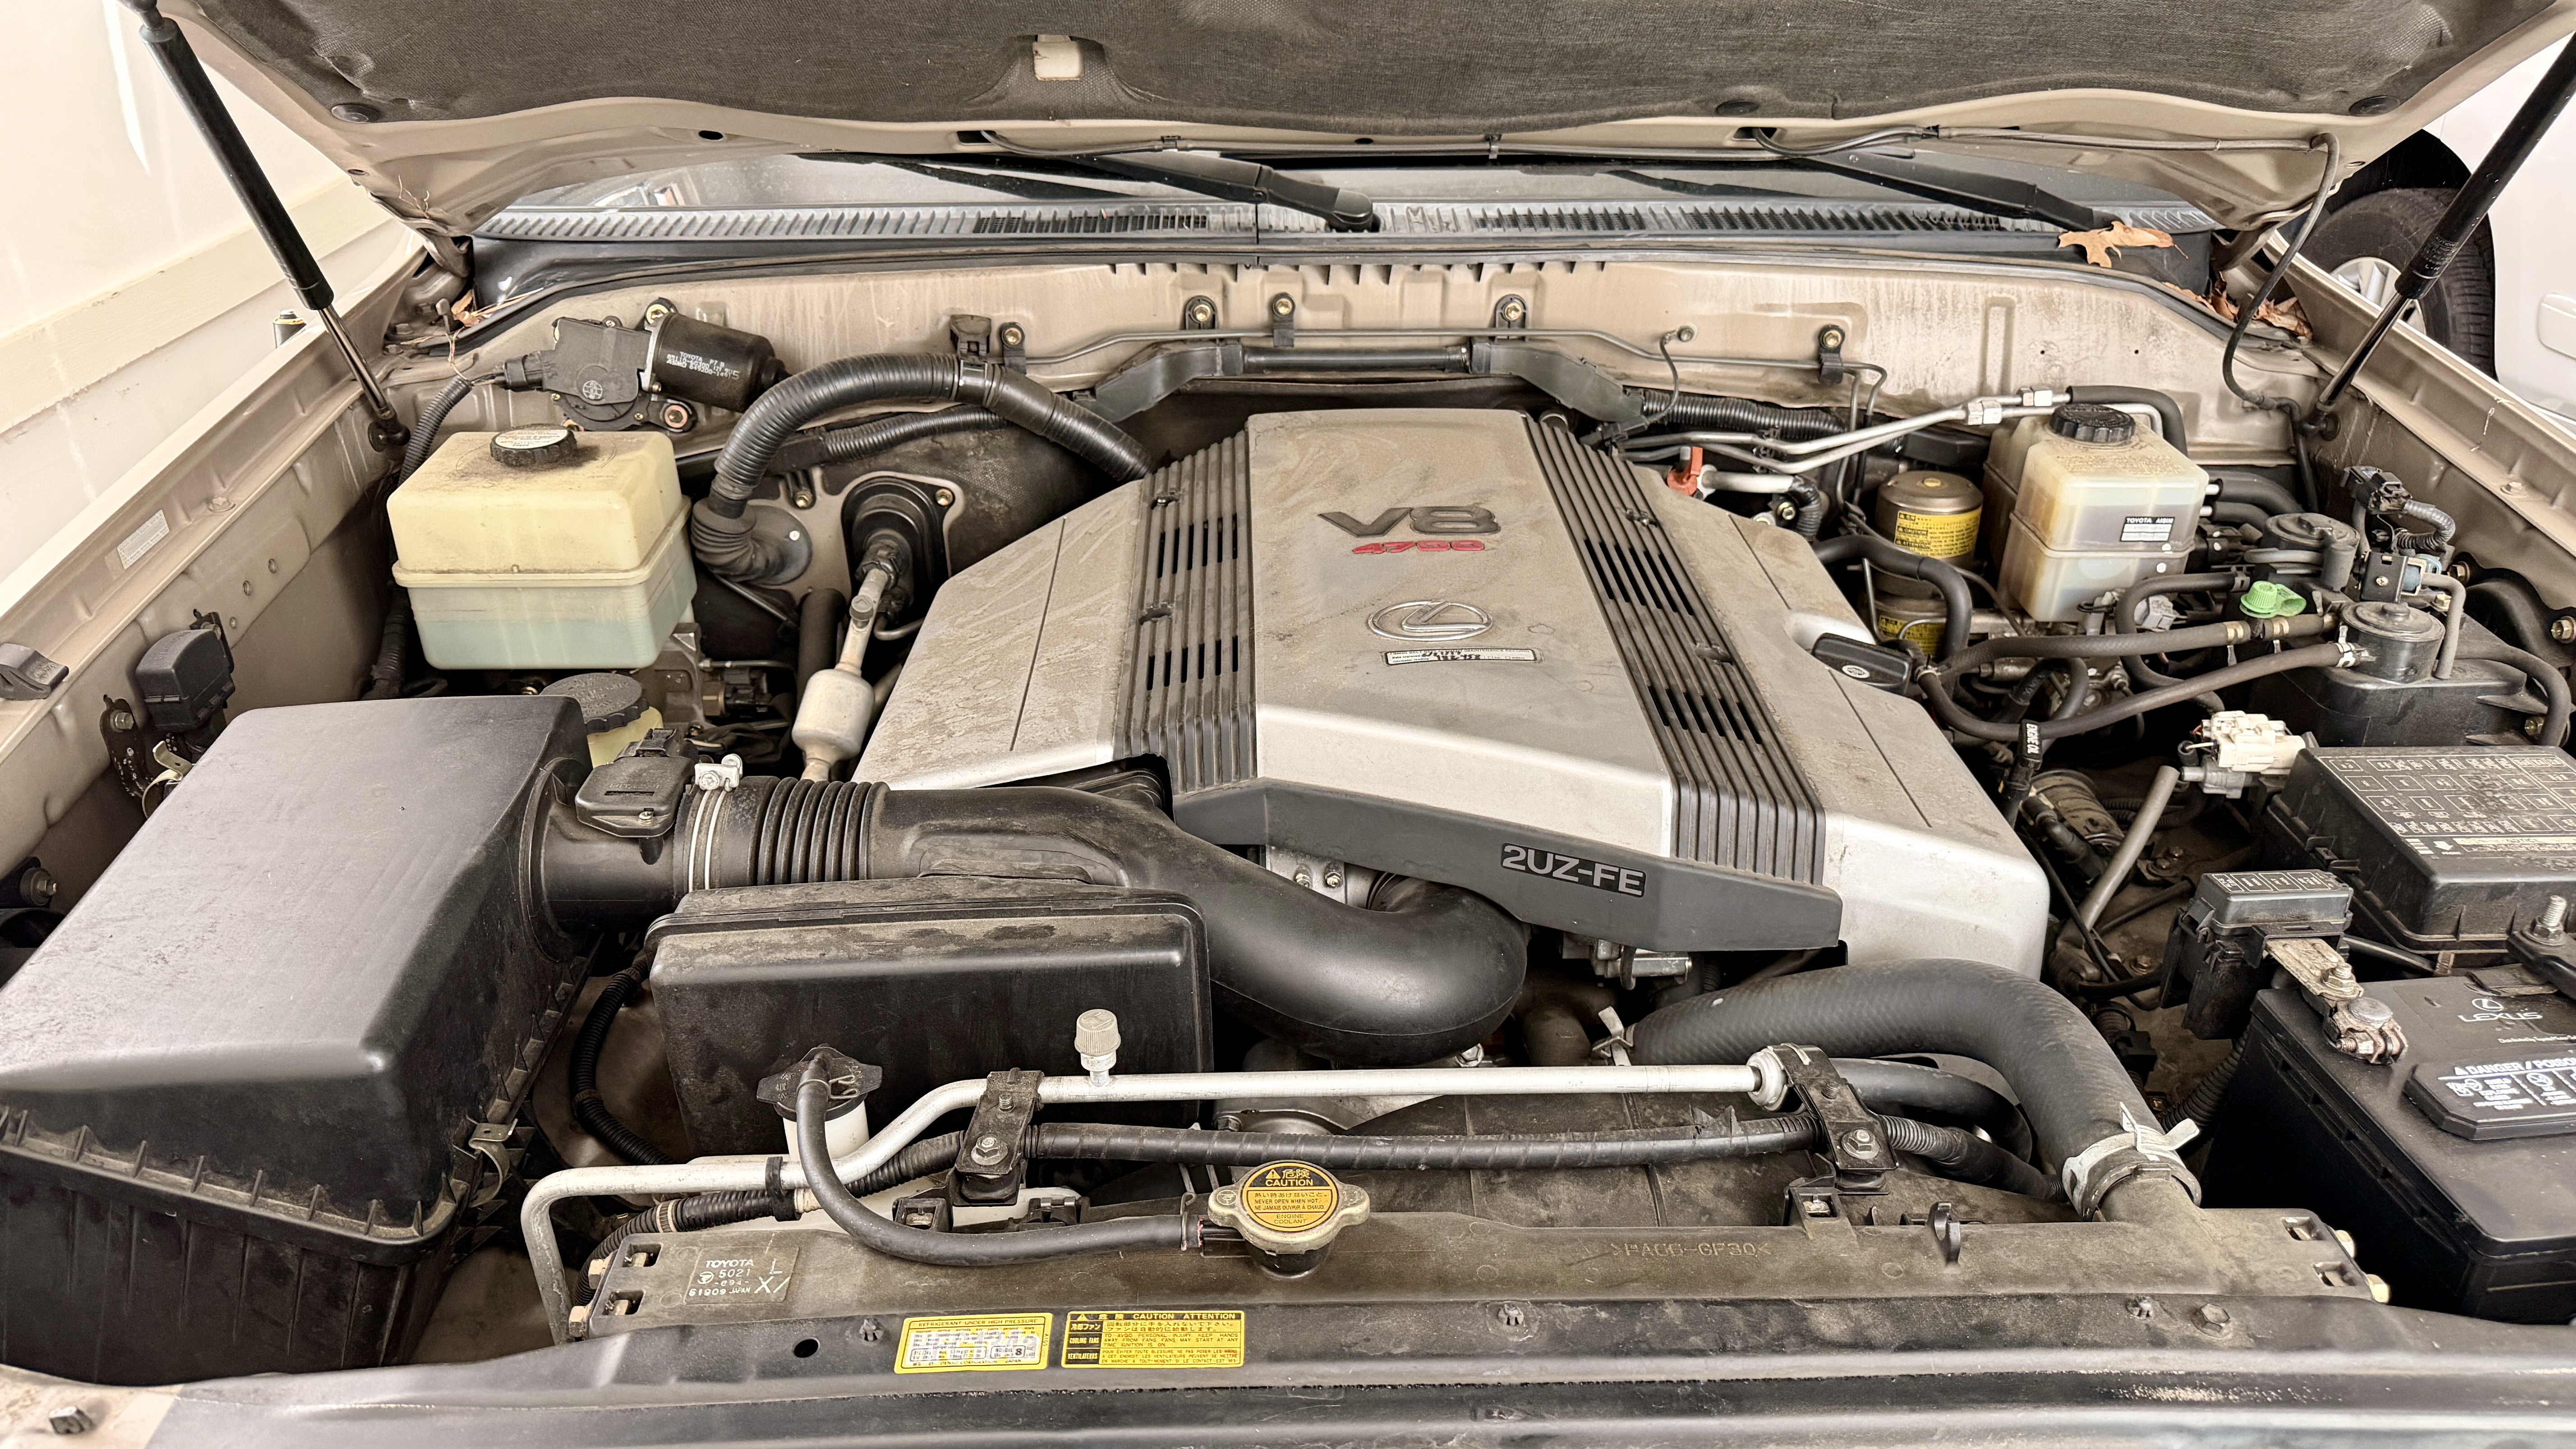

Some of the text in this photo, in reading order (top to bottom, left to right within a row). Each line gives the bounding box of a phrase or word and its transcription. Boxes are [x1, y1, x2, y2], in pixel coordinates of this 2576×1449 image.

[680, 351, 703, 362] TOYOTA
[1317, 506, 1501, 538] V8
[1352, 540, 1485, 554] 4700
[2026, 723, 2039, 754] ENGINE OIL
[1502, 845, 1644, 896] 2UZ-FE
[2458, 1012, 2543, 1022] LEXUS
[2465, 1063, 2526, 1074] DANGER
[1282, 1169, 1311, 1179] 危険
[706, 1259, 754, 1268] TOYOTA
[718, 1269, 750, 1278] 5021
